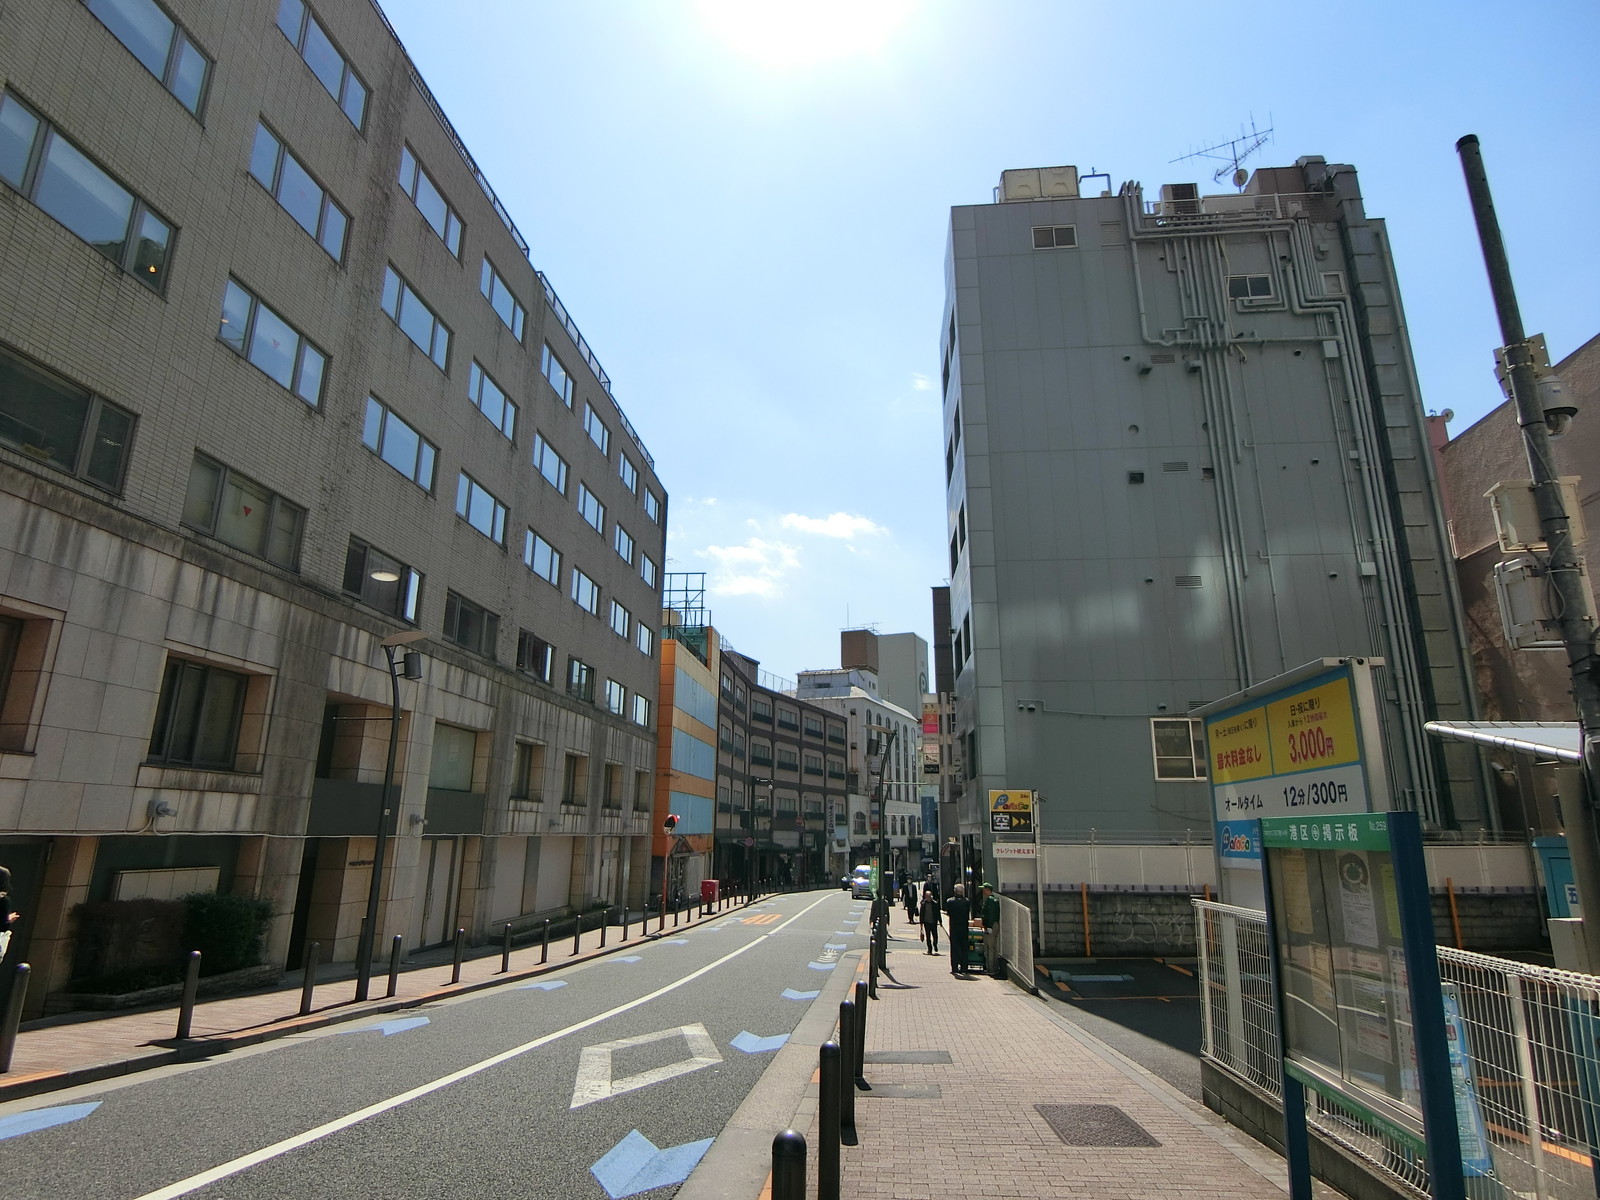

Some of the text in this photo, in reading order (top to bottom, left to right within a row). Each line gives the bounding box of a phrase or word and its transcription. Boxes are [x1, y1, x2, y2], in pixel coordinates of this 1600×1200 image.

[1217, 745, 1262, 770] 最大料金なし
[1288, 726, 1335, 764] 3,000円
[1225, 781, 1348, 811] オールタイム 12分/300円
[1289, 824, 1309, 841] 港区
[1322, 823, 1359, 842] 掲示板
